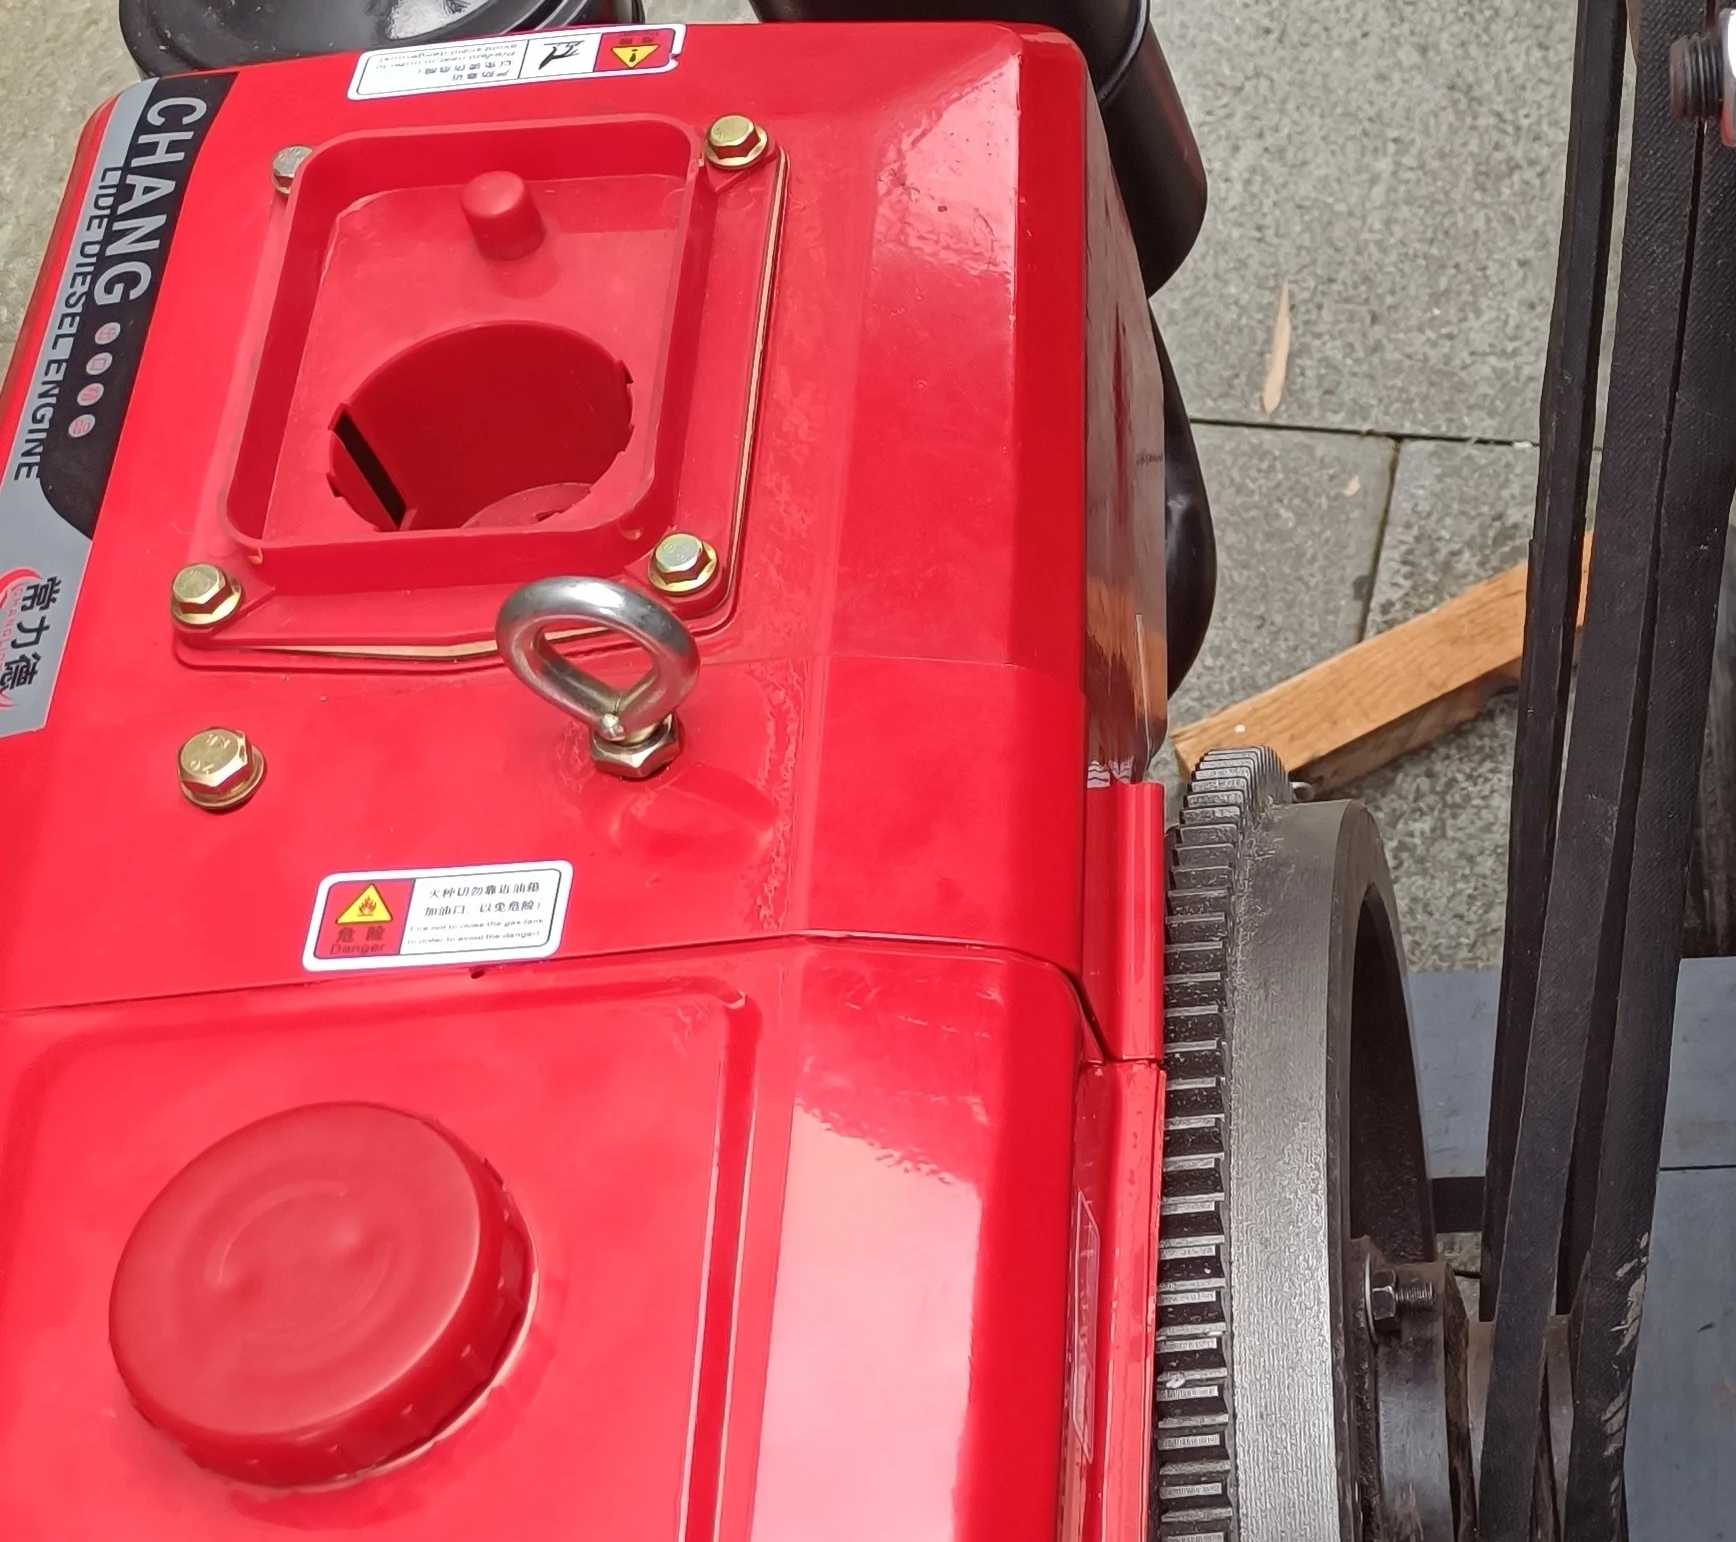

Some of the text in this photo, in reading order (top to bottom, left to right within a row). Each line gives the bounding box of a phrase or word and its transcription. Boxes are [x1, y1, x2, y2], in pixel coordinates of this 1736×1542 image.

[93, 96, 207, 306] CHANG
[13, 165, 123, 482] LIDE DIESEL ENGINE
[0, 575, 61, 692] 常力德
[329, 942, 387, 955] Danger
[335, 925, 387, 943] 危险
